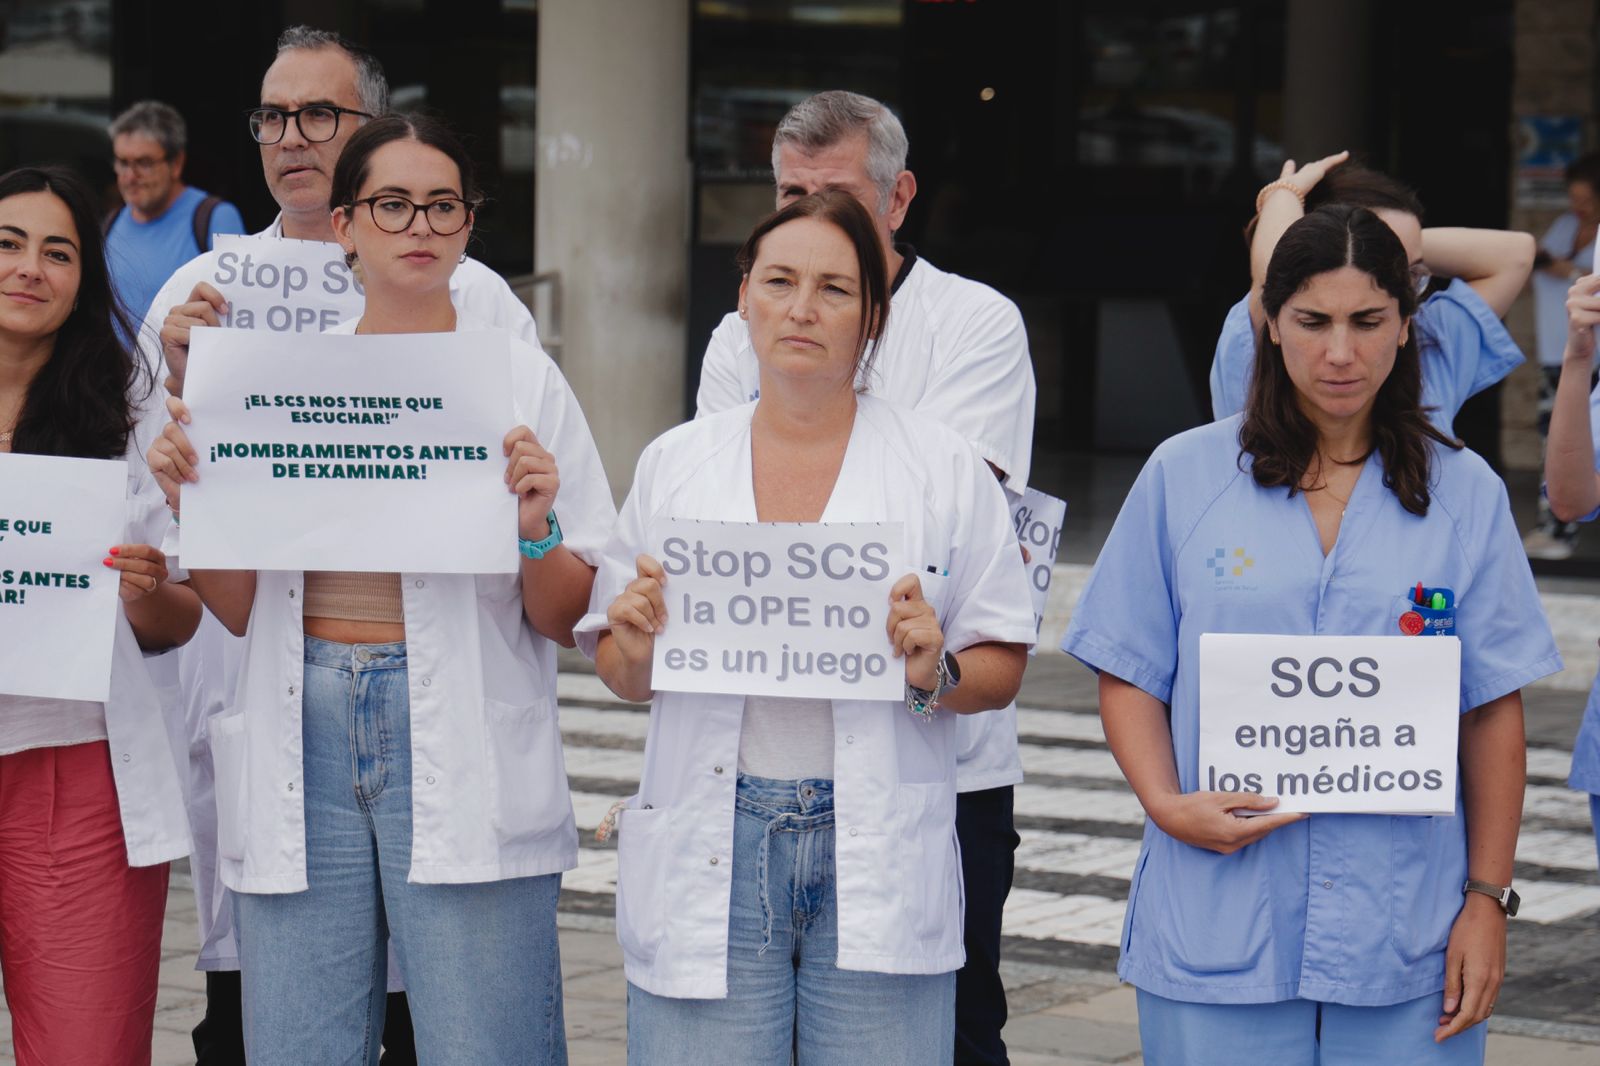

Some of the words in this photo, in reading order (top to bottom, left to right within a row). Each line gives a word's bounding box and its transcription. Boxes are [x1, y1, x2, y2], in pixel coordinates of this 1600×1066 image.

[214, 252, 308, 299] Stop
[226, 301, 254, 329] la
[245, 395, 271, 410] ¡EL
[274, 395, 305, 408] SCS
[309, 396, 346, 409] NOS
[350, 397, 402, 409] TIENE
[406, 397, 443, 412] QUE
[211, 443, 414, 462] ¡NOMBRAMIENTOS
[419, 446, 487, 461] ANTES
[273, 464, 299, 478] DE
[305, 464, 426, 480] EXAMINAR!
[13, 520, 51, 536] QUE
[663, 537, 771, 588] Stop
[786, 542, 889, 581] SCS
[19, 571, 90, 589] ANTES
[0, 589, 25, 604] R!
[683, 593, 715, 626] la
[728, 595, 811, 627] OPE
[824, 604, 871, 629] no
[664, 648, 708, 671] es
[722, 649, 768, 674] un
[776, 643, 888, 684] juego
[1270, 657, 1381, 698] SCS
[1235, 718, 1380, 755] engaña
[1394, 725, 1416, 746] a
[1209, 766, 1263, 795] los
[1277, 765, 1443, 796] médicos
